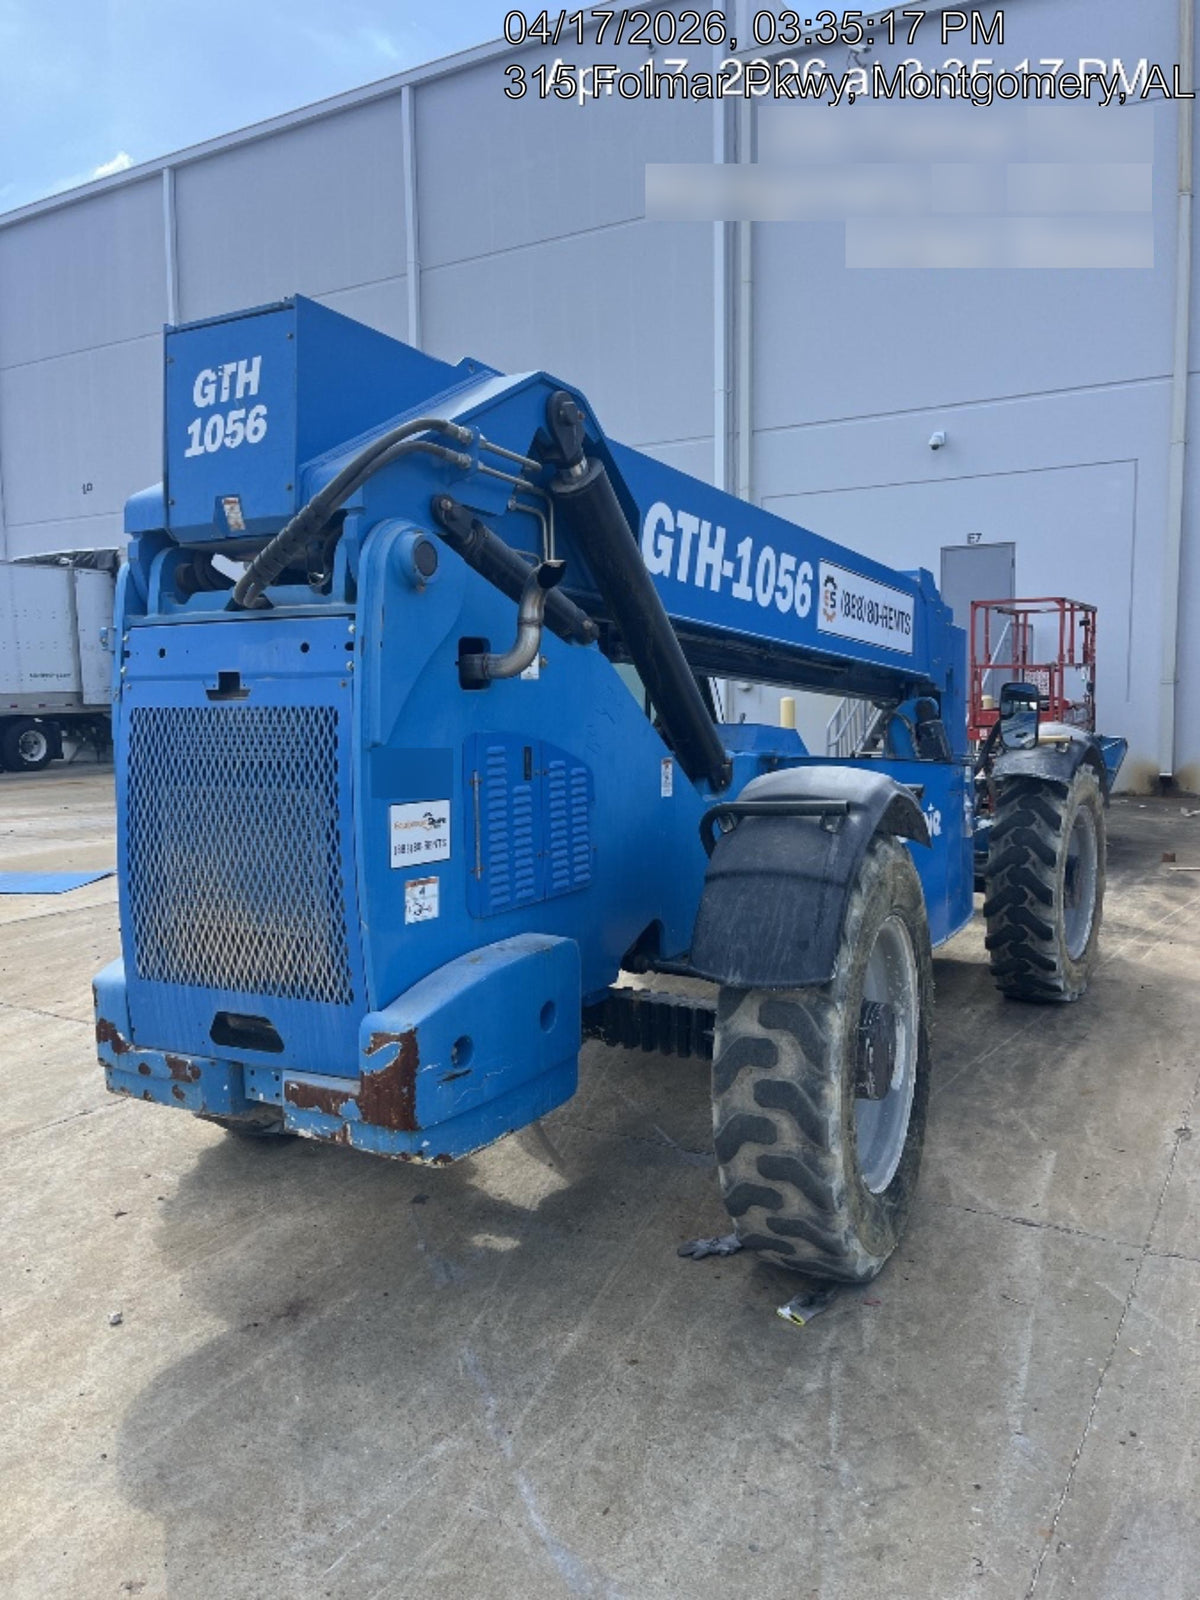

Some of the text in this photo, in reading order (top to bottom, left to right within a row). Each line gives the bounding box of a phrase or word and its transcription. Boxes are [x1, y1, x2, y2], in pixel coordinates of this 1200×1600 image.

[193, 355, 262, 408] GTH
[184, 404, 268, 458] 1056
[641, 501, 814, 618] GTH-1056
